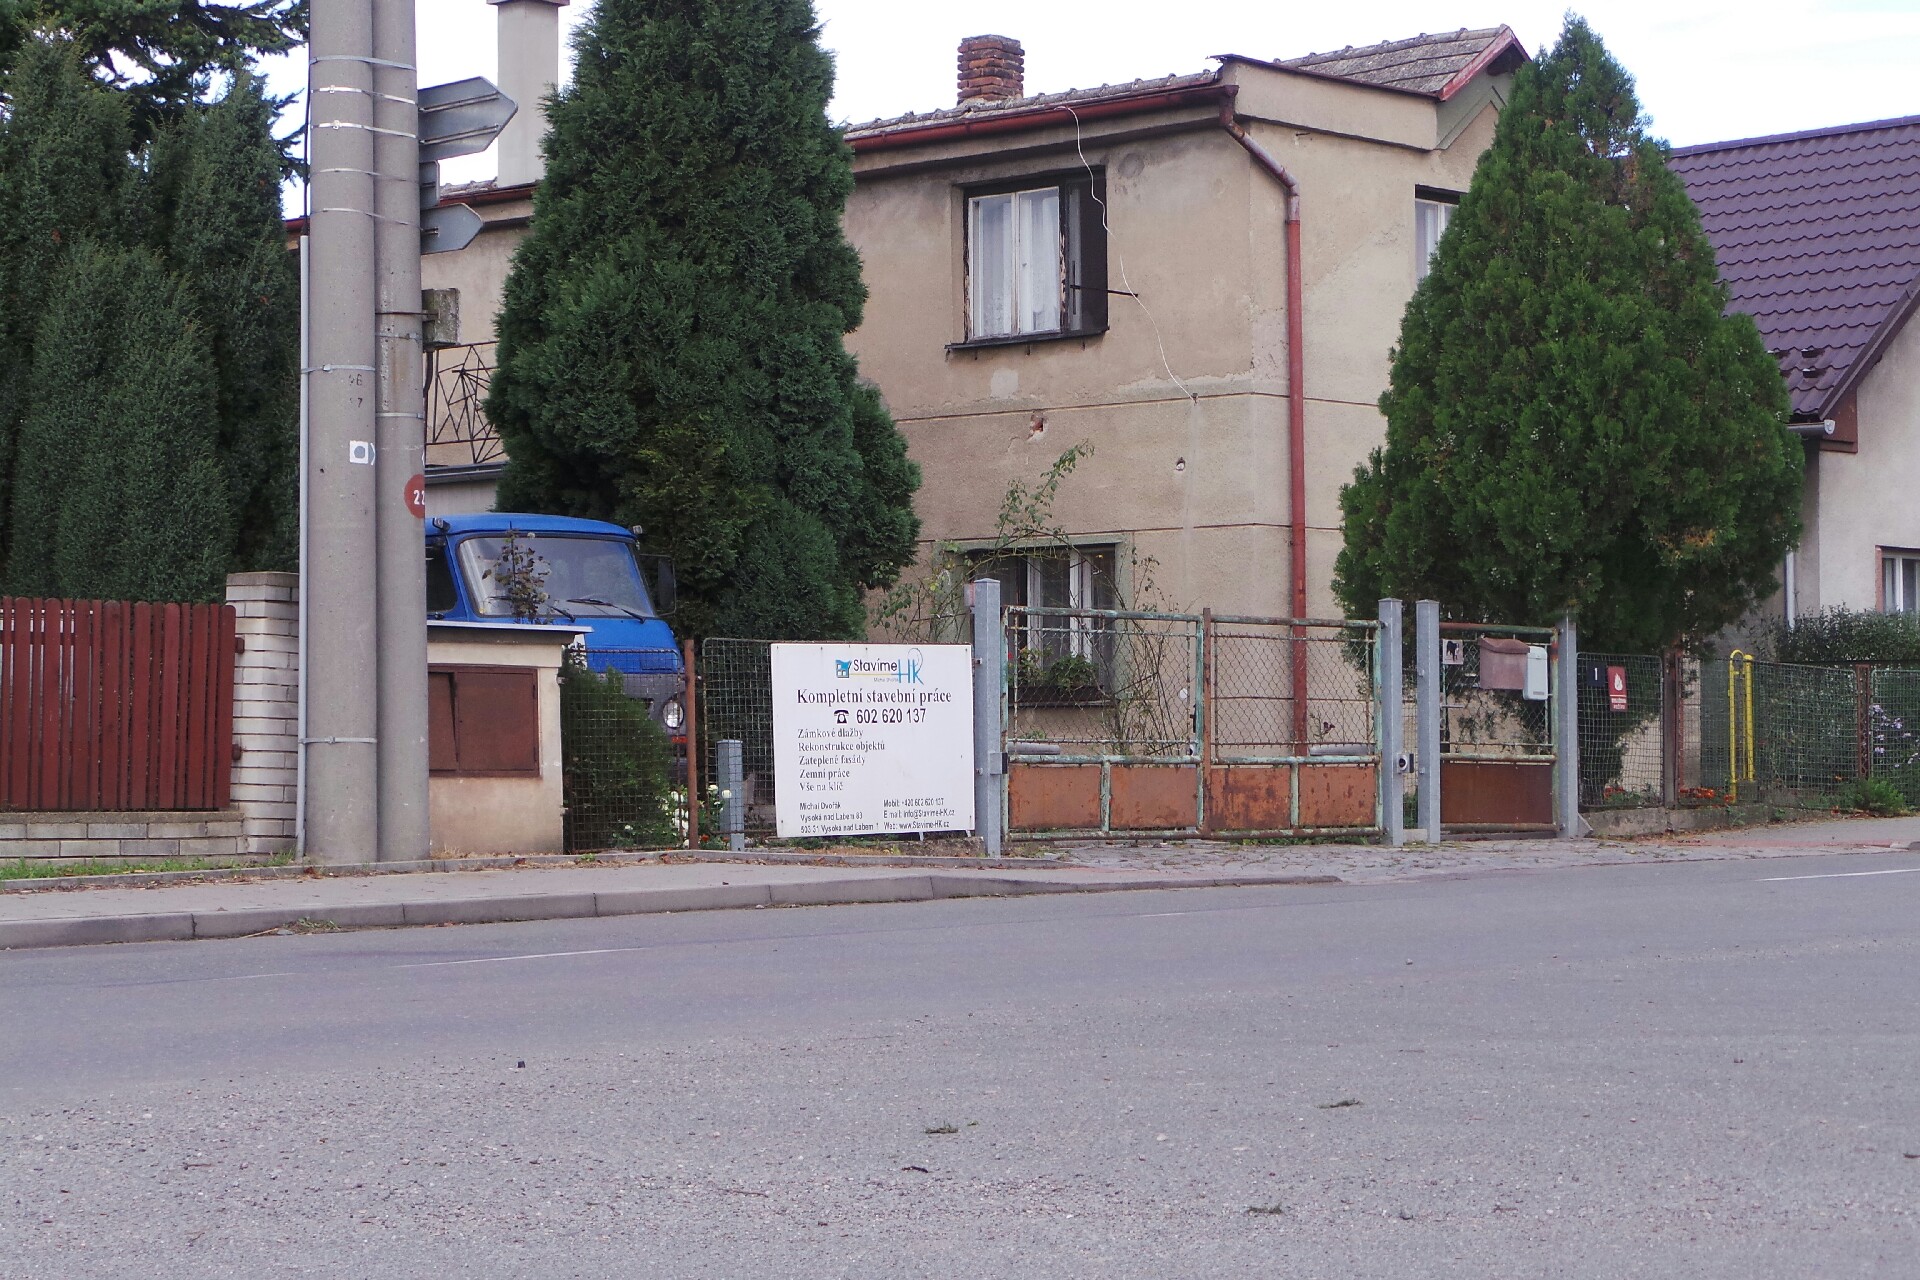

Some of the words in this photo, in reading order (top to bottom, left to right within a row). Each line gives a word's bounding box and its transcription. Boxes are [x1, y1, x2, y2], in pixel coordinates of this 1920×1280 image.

[853, 658, 897, 672] Stavíme
[797, 688, 863, 706] Kompletní
[866, 688, 915, 703] stavební
[920, 688, 951, 706] práce
[856, 709, 878, 724] 602
[882, 709, 903, 723] 620
[907, 708, 926, 723] 137
[798, 728, 836, 739] Zámkové
[838, 728, 863, 739] dlažby
[798, 742, 854, 752] Rekonstrukce
[856, 740, 885, 753] objektů
[799, 755, 839, 767] Zateplené
[841, 754, 865, 766] fasády
[800, 768, 826, 779] Zemní
[828, 769, 850, 780] práce
[800, 783, 814, 792] Vše
[828, 782, 844, 791] klíč
